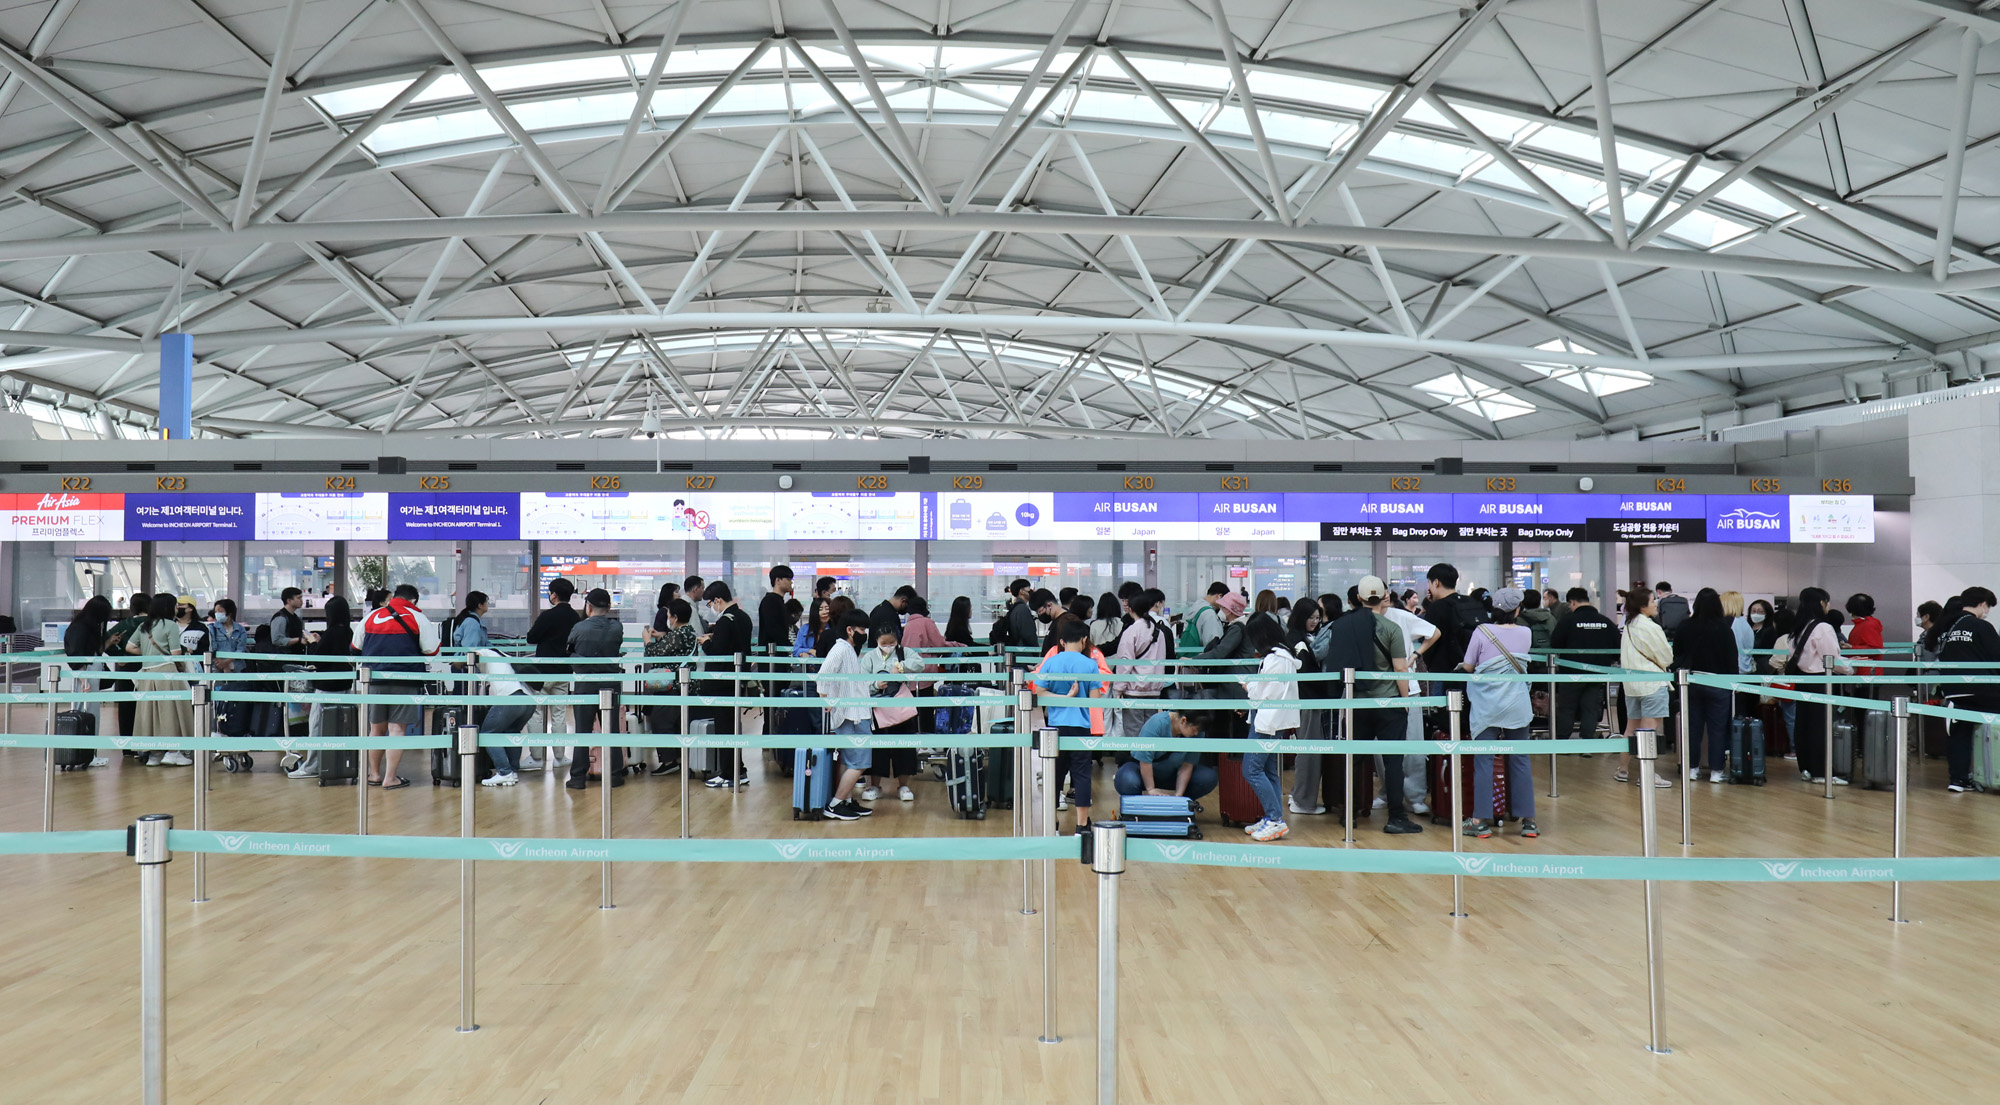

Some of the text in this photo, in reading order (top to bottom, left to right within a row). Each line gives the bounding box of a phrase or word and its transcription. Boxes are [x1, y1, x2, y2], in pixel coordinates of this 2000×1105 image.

[61, 477, 90, 490] K22
[156, 477, 186, 490] K23
[325, 476, 355, 489] K24
[420, 476, 449, 489] K25
[590, 476, 620, 489] K26
[686, 476, 715, 489] K27
[857, 476, 887, 489] K28
[953, 476, 983, 489] K29
[1123, 476, 1154, 490] K30
[1221, 476, 1249, 490] K31
[1391, 477, 1420, 490] K32
[1486, 477, 1516, 490] K33
[1656, 478, 1685, 491] K34
[1751, 479, 1781, 492] K35
[1822, 479, 1851, 492] K36
[136, 505, 244, 516] 여기는 제1여객터미널 입니다.
[400, 504, 508, 516] 여기는 제1여객터미널 입니다.
[1094, 502, 1157, 513] AIR BUSAN
[1213, 503, 1277, 513] AIR BUSAN
[1360, 503, 1424, 514] AIR BUSAN
[1480, 504, 1543, 514] AIR BUSAN
[1620, 502, 1672, 511] AIR BUSAN
[12, 516, 104, 525] PREMIUM FLEX
[1717, 519, 1780, 529] AIR BUSAN
[32, 528, 85, 536] 프리미엄플렉스
[1095, 527, 1111, 536] 일본
[1132, 527, 1156, 537] Japan
[1215, 527, 1231, 536] 일본
[1251, 528, 1275, 537] Japan
[1332, 527, 1382, 537] 짐만 부치는 곳
[1392, 528, 1448, 538] Bag Drop Only
[1459, 527, 1508, 537] 짐만 부치는 곳
[1518, 528, 1574, 538] Bag Drop Only
[1613, 523, 1680, 533] 도심공항 전용 카운터
[157, 741, 180, 749] Airport
[323, 741, 346, 749] Airport
[555, 738, 578, 746] Airport
[726, 739, 749, 747] Airport
[898, 739, 922, 747] Airport
[1309, 744, 1334, 752] Airport
[249, 841, 330, 854] Incheon Airport
[525, 847, 609, 858] Incheon Airport
[808, 847, 895, 858] Incheon Airport
[1192, 850, 1281, 865] Incheon Airport
[1492, 862, 1584, 876] Incheon Airport
[1800, 867, 1894, 879] Incheon Airport
